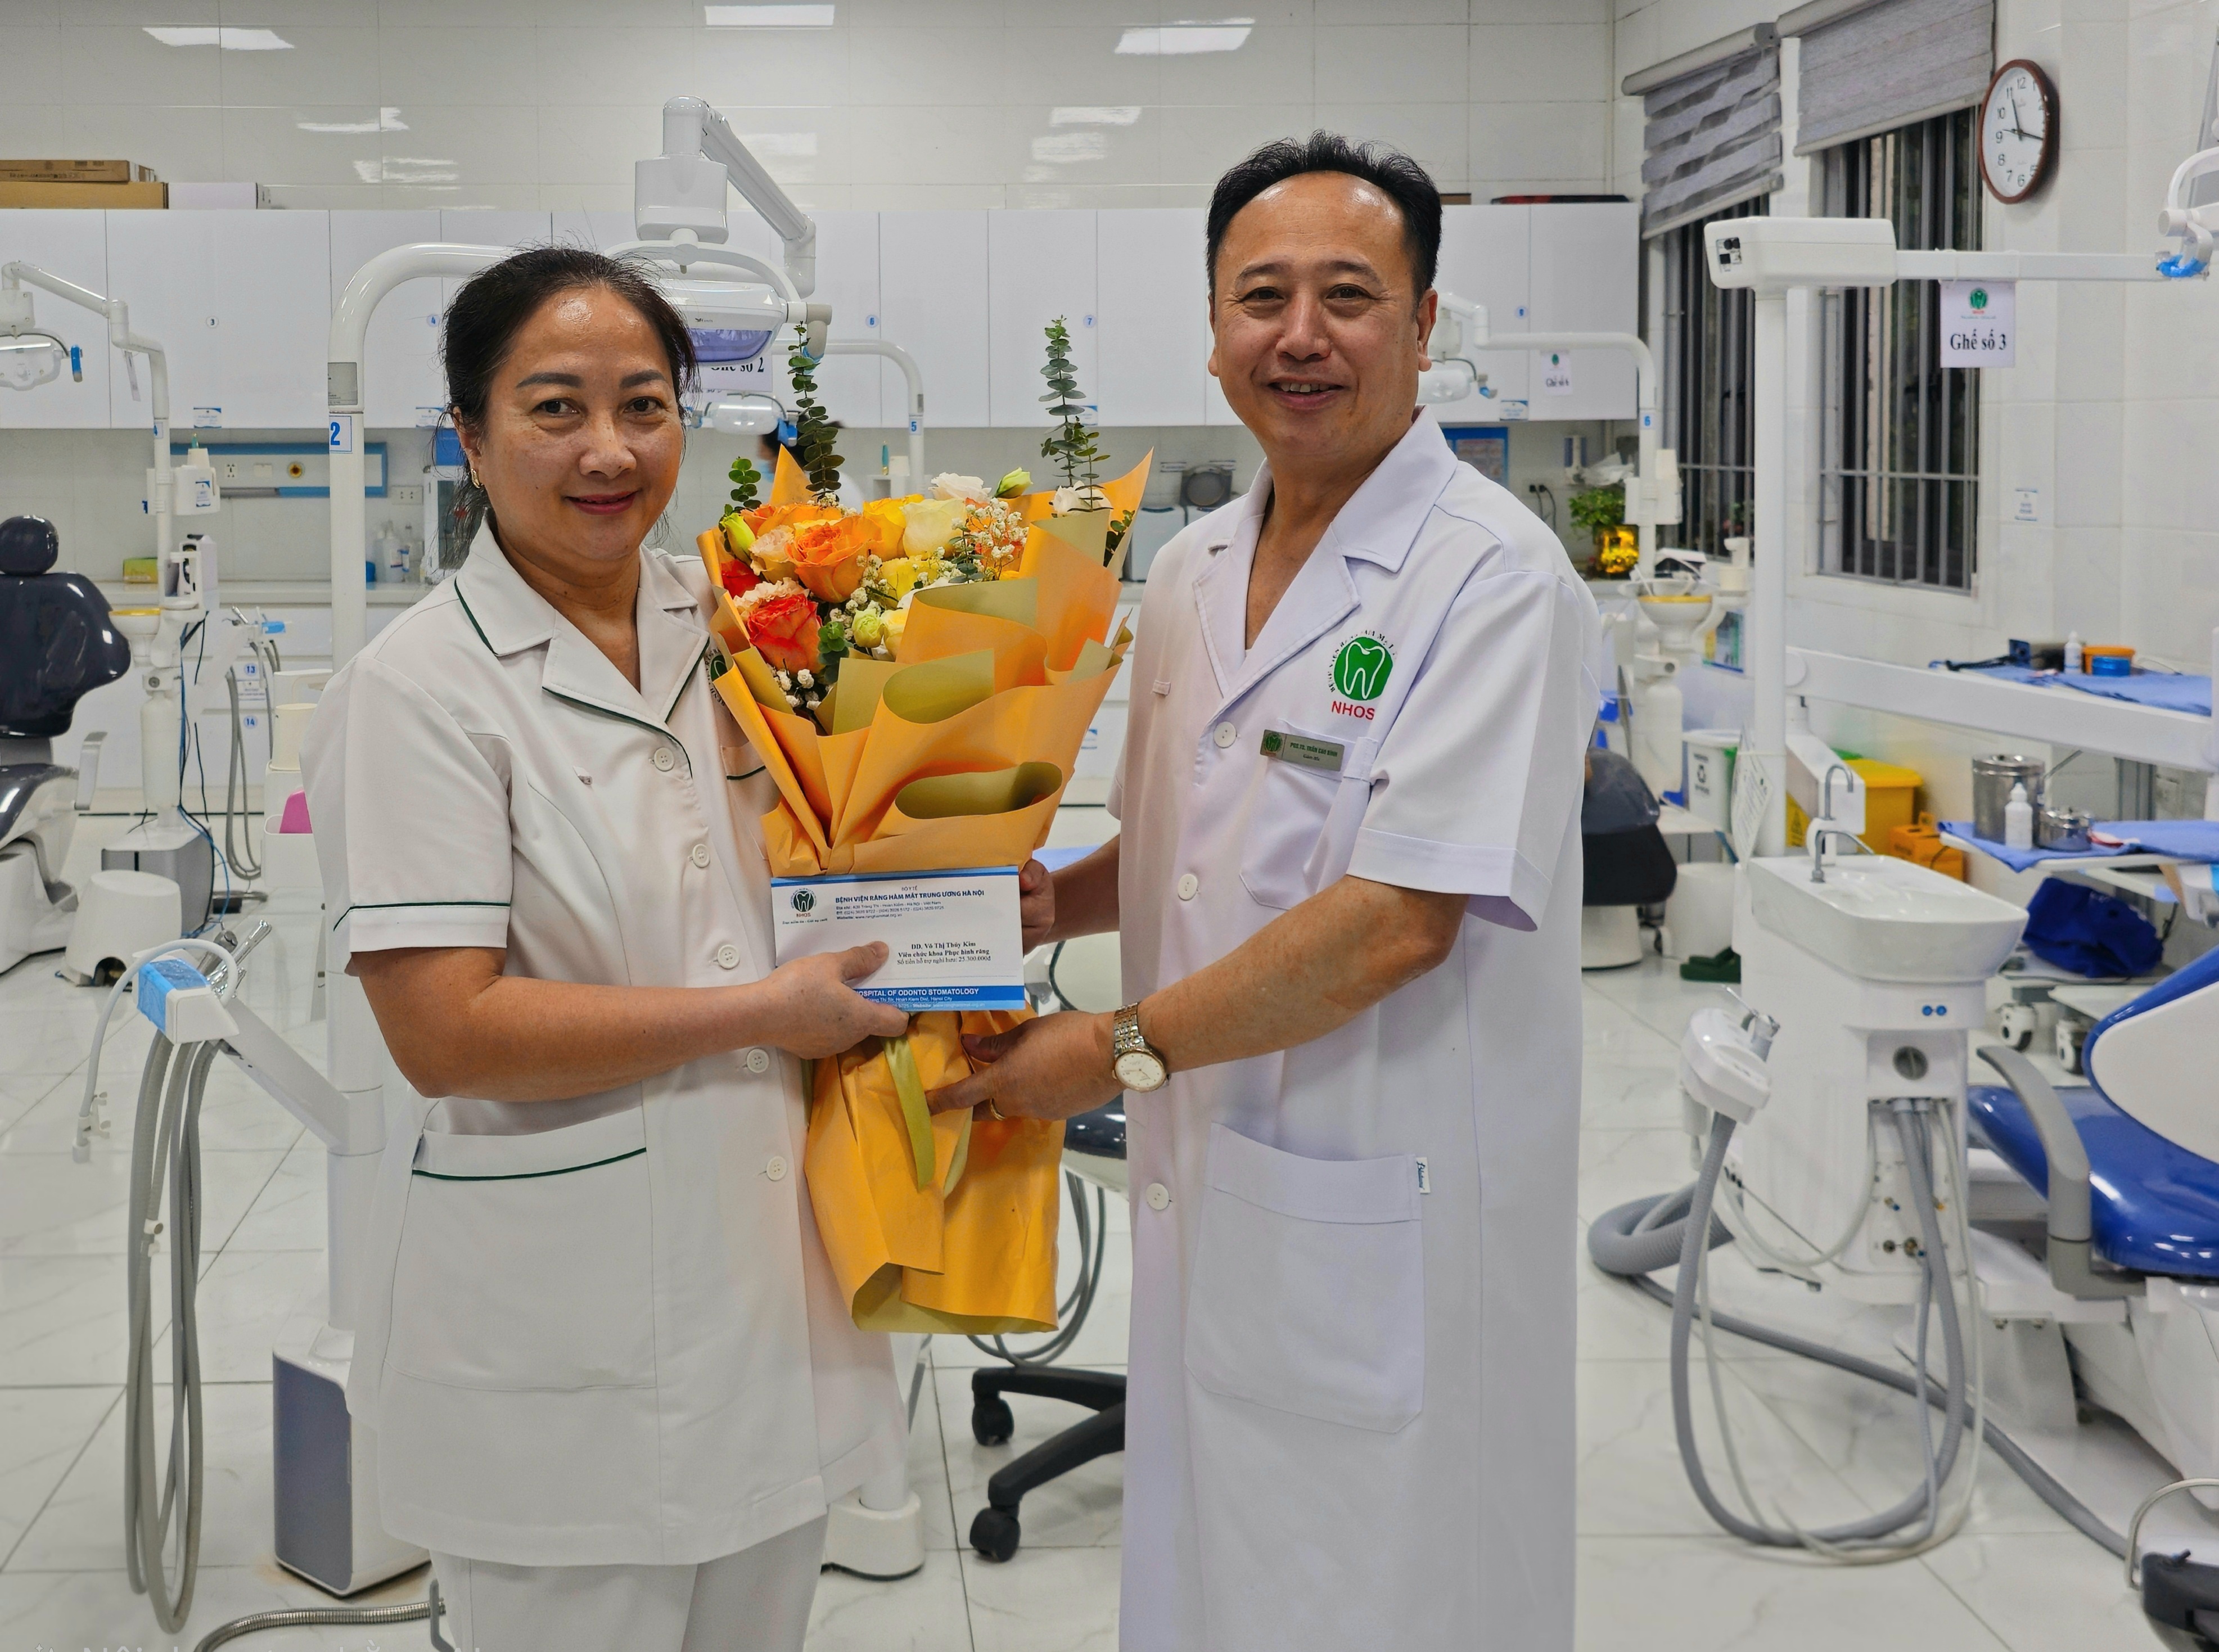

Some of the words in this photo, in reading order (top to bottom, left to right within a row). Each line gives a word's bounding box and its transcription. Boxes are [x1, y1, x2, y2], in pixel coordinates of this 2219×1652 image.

[2017, 77, 2026, 89] 12
[2006, 87, 2013, 99] 11
[1997, 107, 2005, 119] 10
[1996, 130, 2002, 143] 9
[1997, 154, 2005, 166] 8
[2006, 169, 2013, 182] 7
[2017, 174, 2025, 187] 6
[1950, 329, 1977, 350] Ghế
[1981, 329, 1995, 350] số
[1999, 333, 2006, 350] 3
[757, 356, 764, 372] 2
[911, 421, 917, 431] 5
[1645, 416, 1650, 426] 6
[330, 422, 340, 445] 2
[1332, 701, 1375, 720] NHOS
